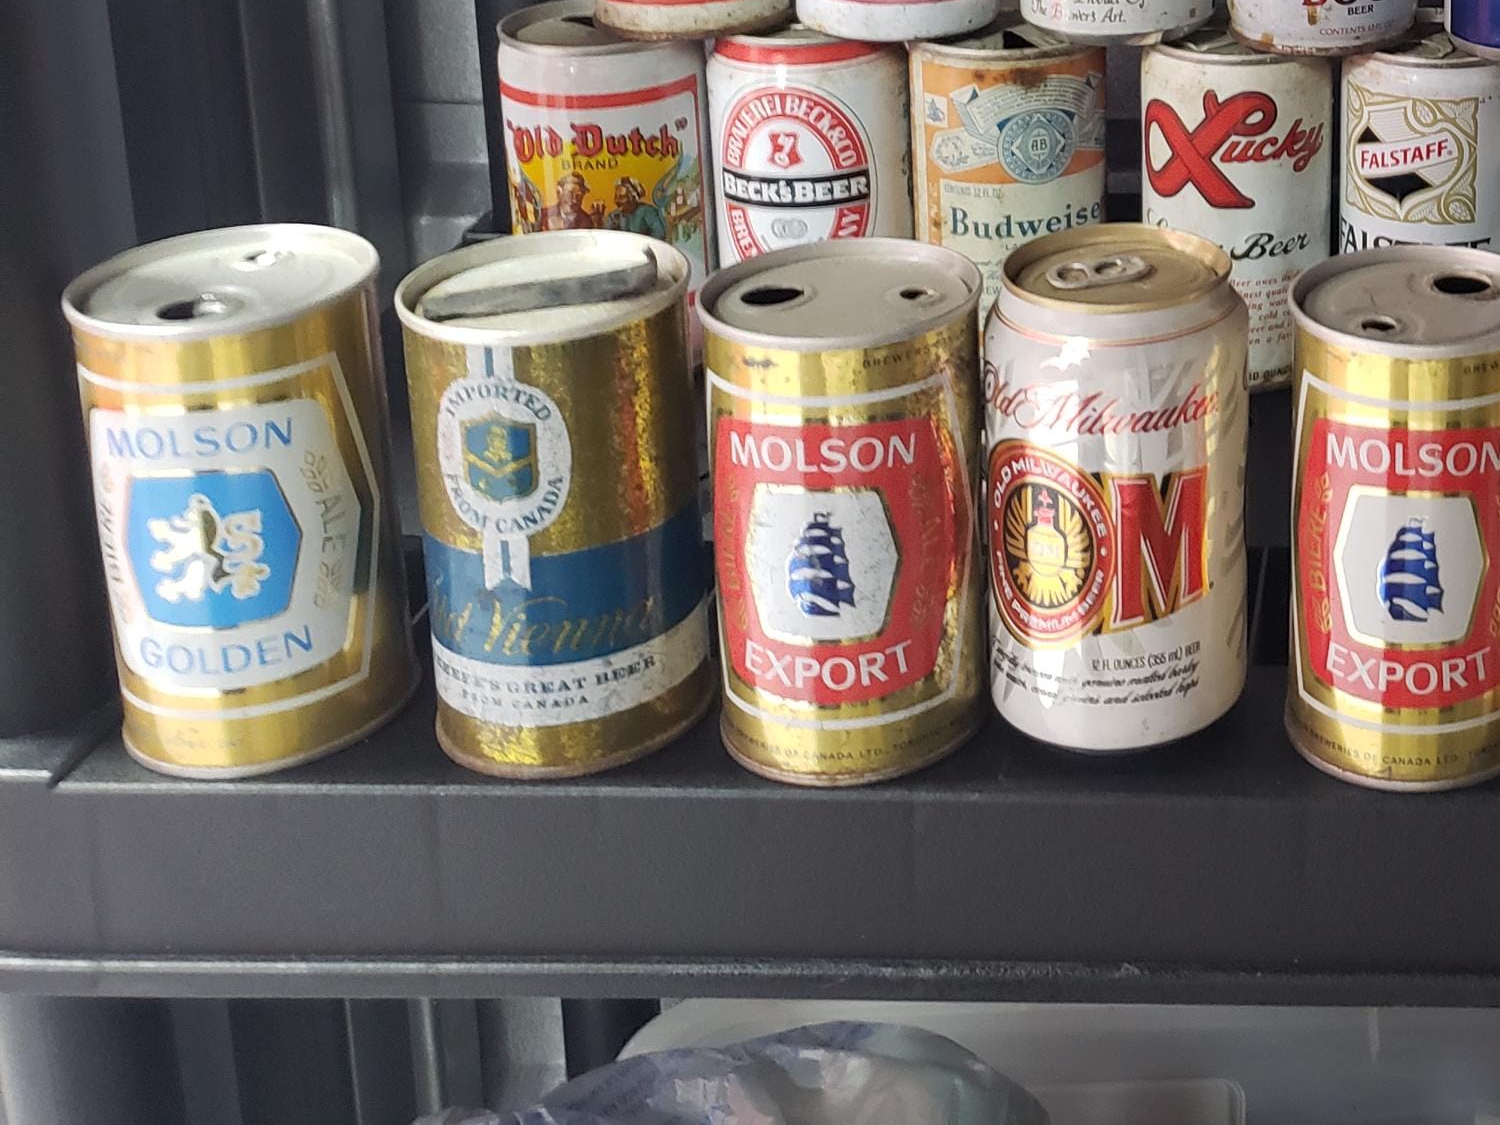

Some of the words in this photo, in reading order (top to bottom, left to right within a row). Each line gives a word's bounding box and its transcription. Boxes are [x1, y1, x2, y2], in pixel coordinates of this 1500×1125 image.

[1032, 0, 1048, 18] The
[1100, 5, 1127, 24] Art.
[1348, 4, 1375, 17] BEER
[1319, 25, 1366, 38] CONTENTS
[728, 94, 782, 167] BRAUEREI
[562, 158, 619, 171] BRAND
[1144, 90, 1325, 209] Lucky
[1360, 137, 1448, 169] FALSTAFF
[793, 175, 869, 203] BEER
[1231, 231, 1311, 260] Beer
[446, 385, 552, 422] IMPORTED
[983, 362, 1017, 420] Old
[106, 417, 293, 460] MOLSON
[729, 429, 918, 473] MOLSON
[448, 472, 492, 530] FROM
[495, 474, 565, 535] CANADA
[1013, 457, 1108, 539] MILWAUKEE
[313, 496, 347, 551] ALE
[1013, 602, 1079, 632] PREMIUM
[140, 625, 314, 675] GOLDEN
[744, 638, 914, 692] EXPORT
[1113, 657, 1146, 671] OUNCES
[1326, 641, 1492, 696] EXPORT
[507, 677, 587, 696] GREAT
[596, 655, 656, 686] BEER
[462, 689, 501, 708] FROM
[512, 694, 589, 709] CANADA
[804, 749, 854, 761] CANADA
[1382, 756, 1433, 767] CANADA
